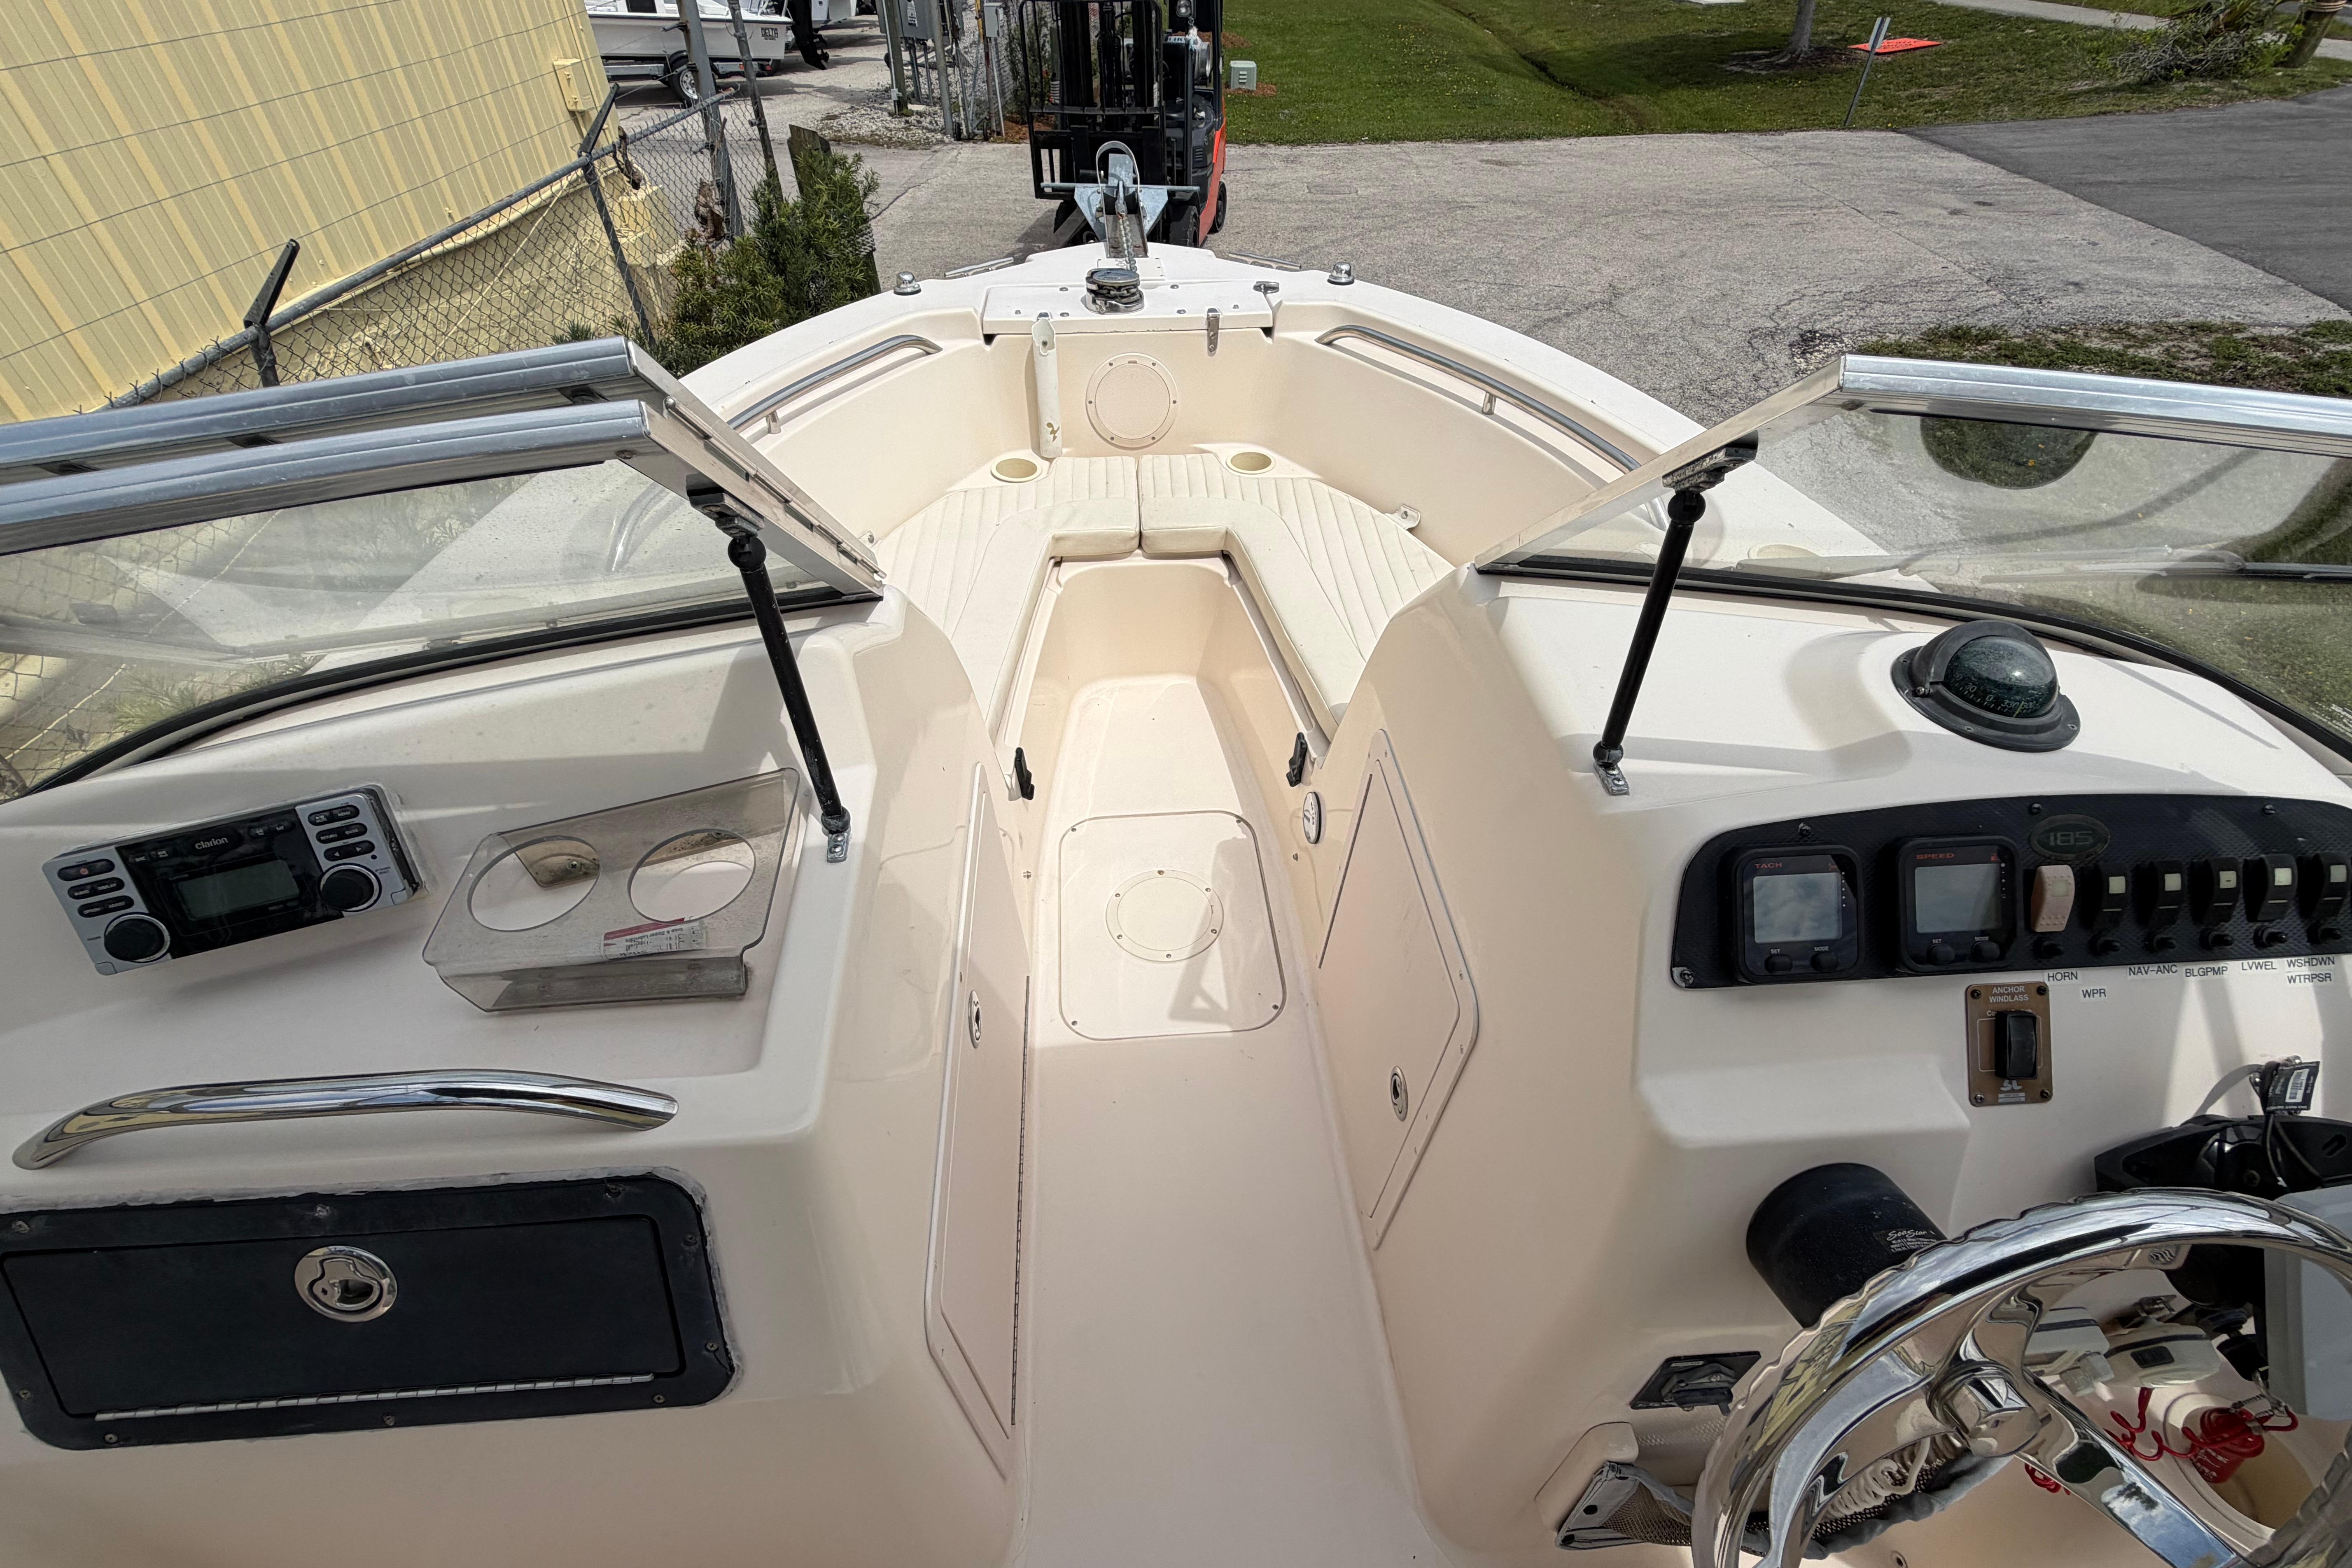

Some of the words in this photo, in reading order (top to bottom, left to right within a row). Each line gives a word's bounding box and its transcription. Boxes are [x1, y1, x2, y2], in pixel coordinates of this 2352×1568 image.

[761, 27, 778, 38] DELTA
[2002, 700, 2019, 709] 330
[195, 838, 229, 849] clarion
[2049, 831, 2093, 846] 185
[2241, 961, 2277, 971] LVWEL
[2287, 957, 2335, 968] WSHDWN
[2128, 964, 2178, 976] NAV-ANC
[2185, 966, 2228, 977] BLGPMP
[2047, 971, 2078, 981] HORN
[2287, 973, 2332, 984] WTRPSR
[1992, 985, 2025, 994] ANCHOR
[2082, 988, 2107, 998] WPR
[1989, 994, 2029, 1003] WINDLASS
